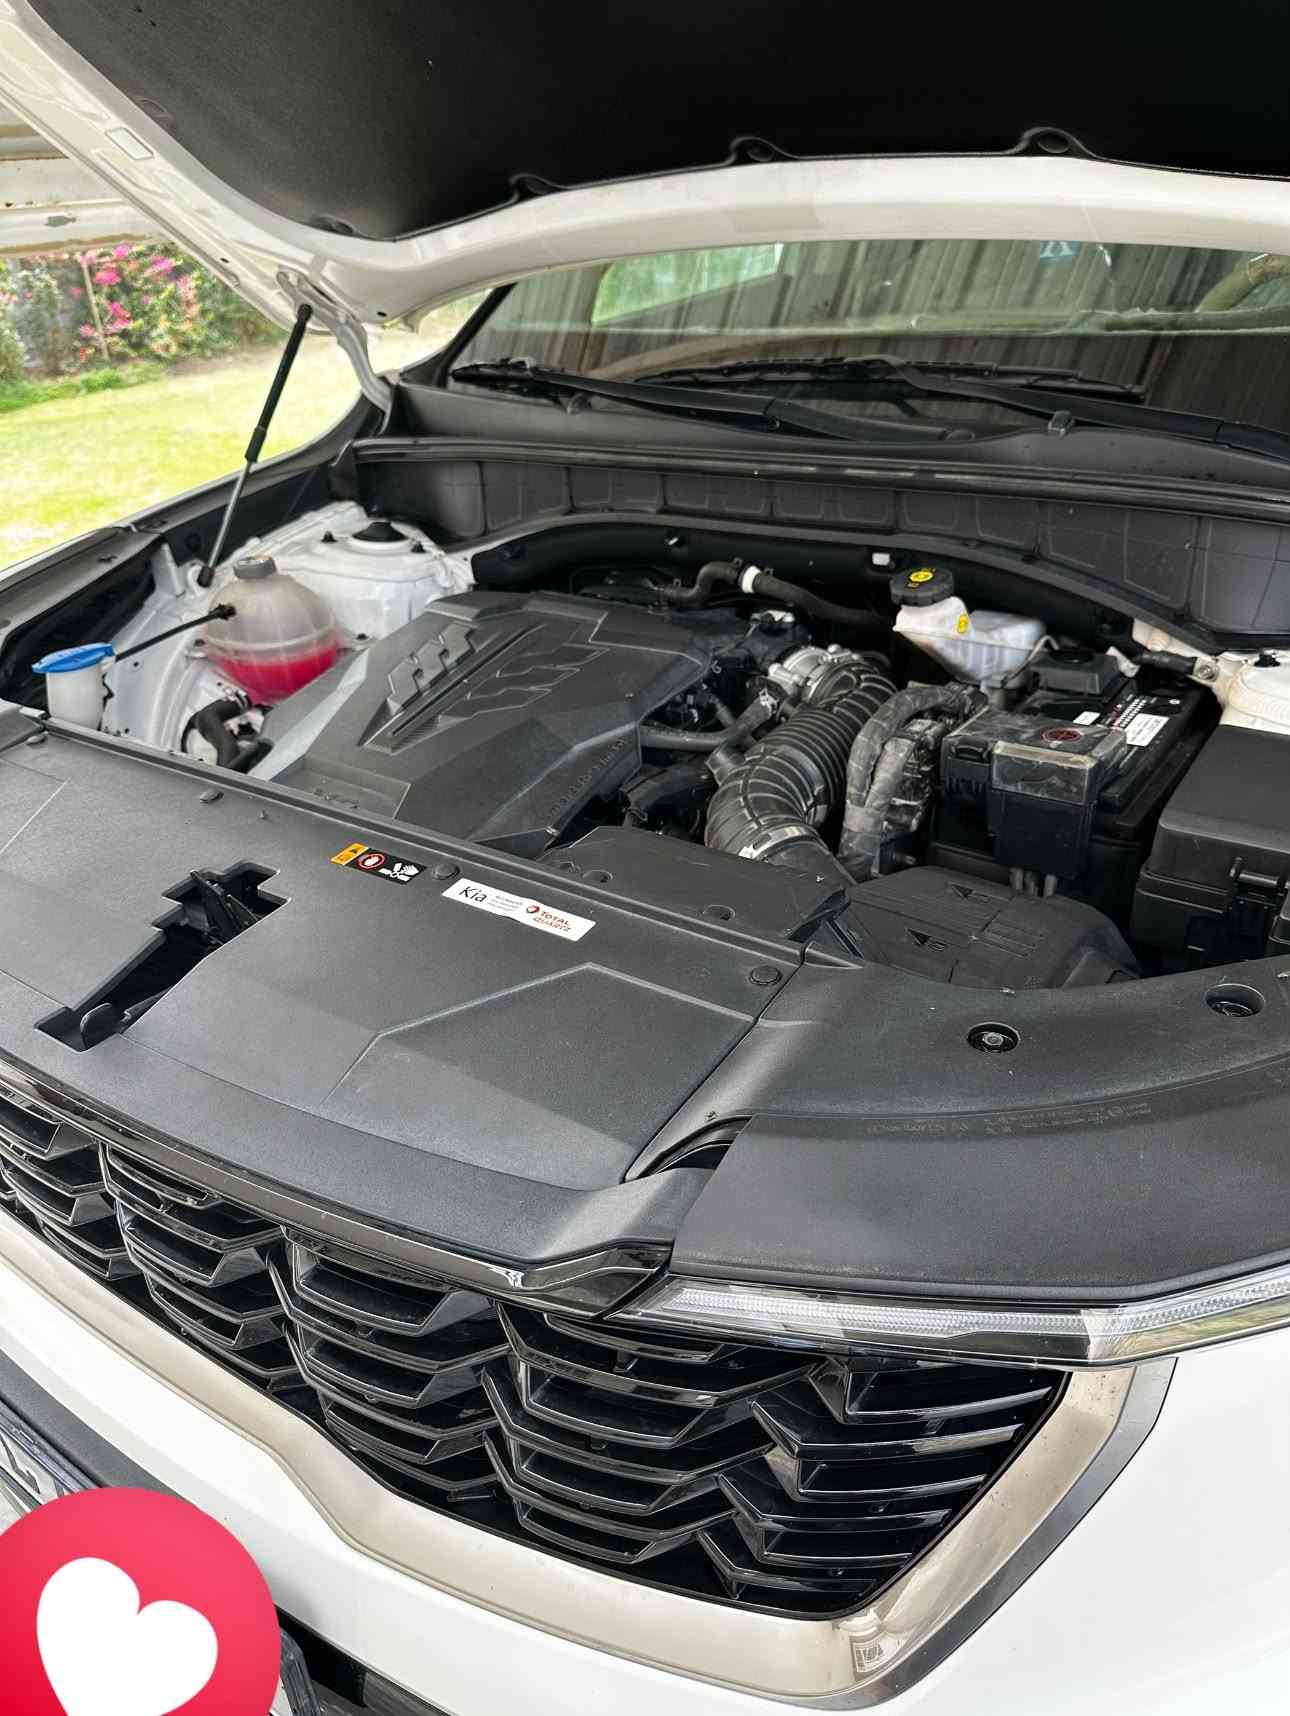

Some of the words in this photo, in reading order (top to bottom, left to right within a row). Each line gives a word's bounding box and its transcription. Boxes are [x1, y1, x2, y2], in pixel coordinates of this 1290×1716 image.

[458, 886, 487, 902] Kia
[532, 917, 572, 932] QUARTZ
[540, 911, 570, 926] TOTAL
